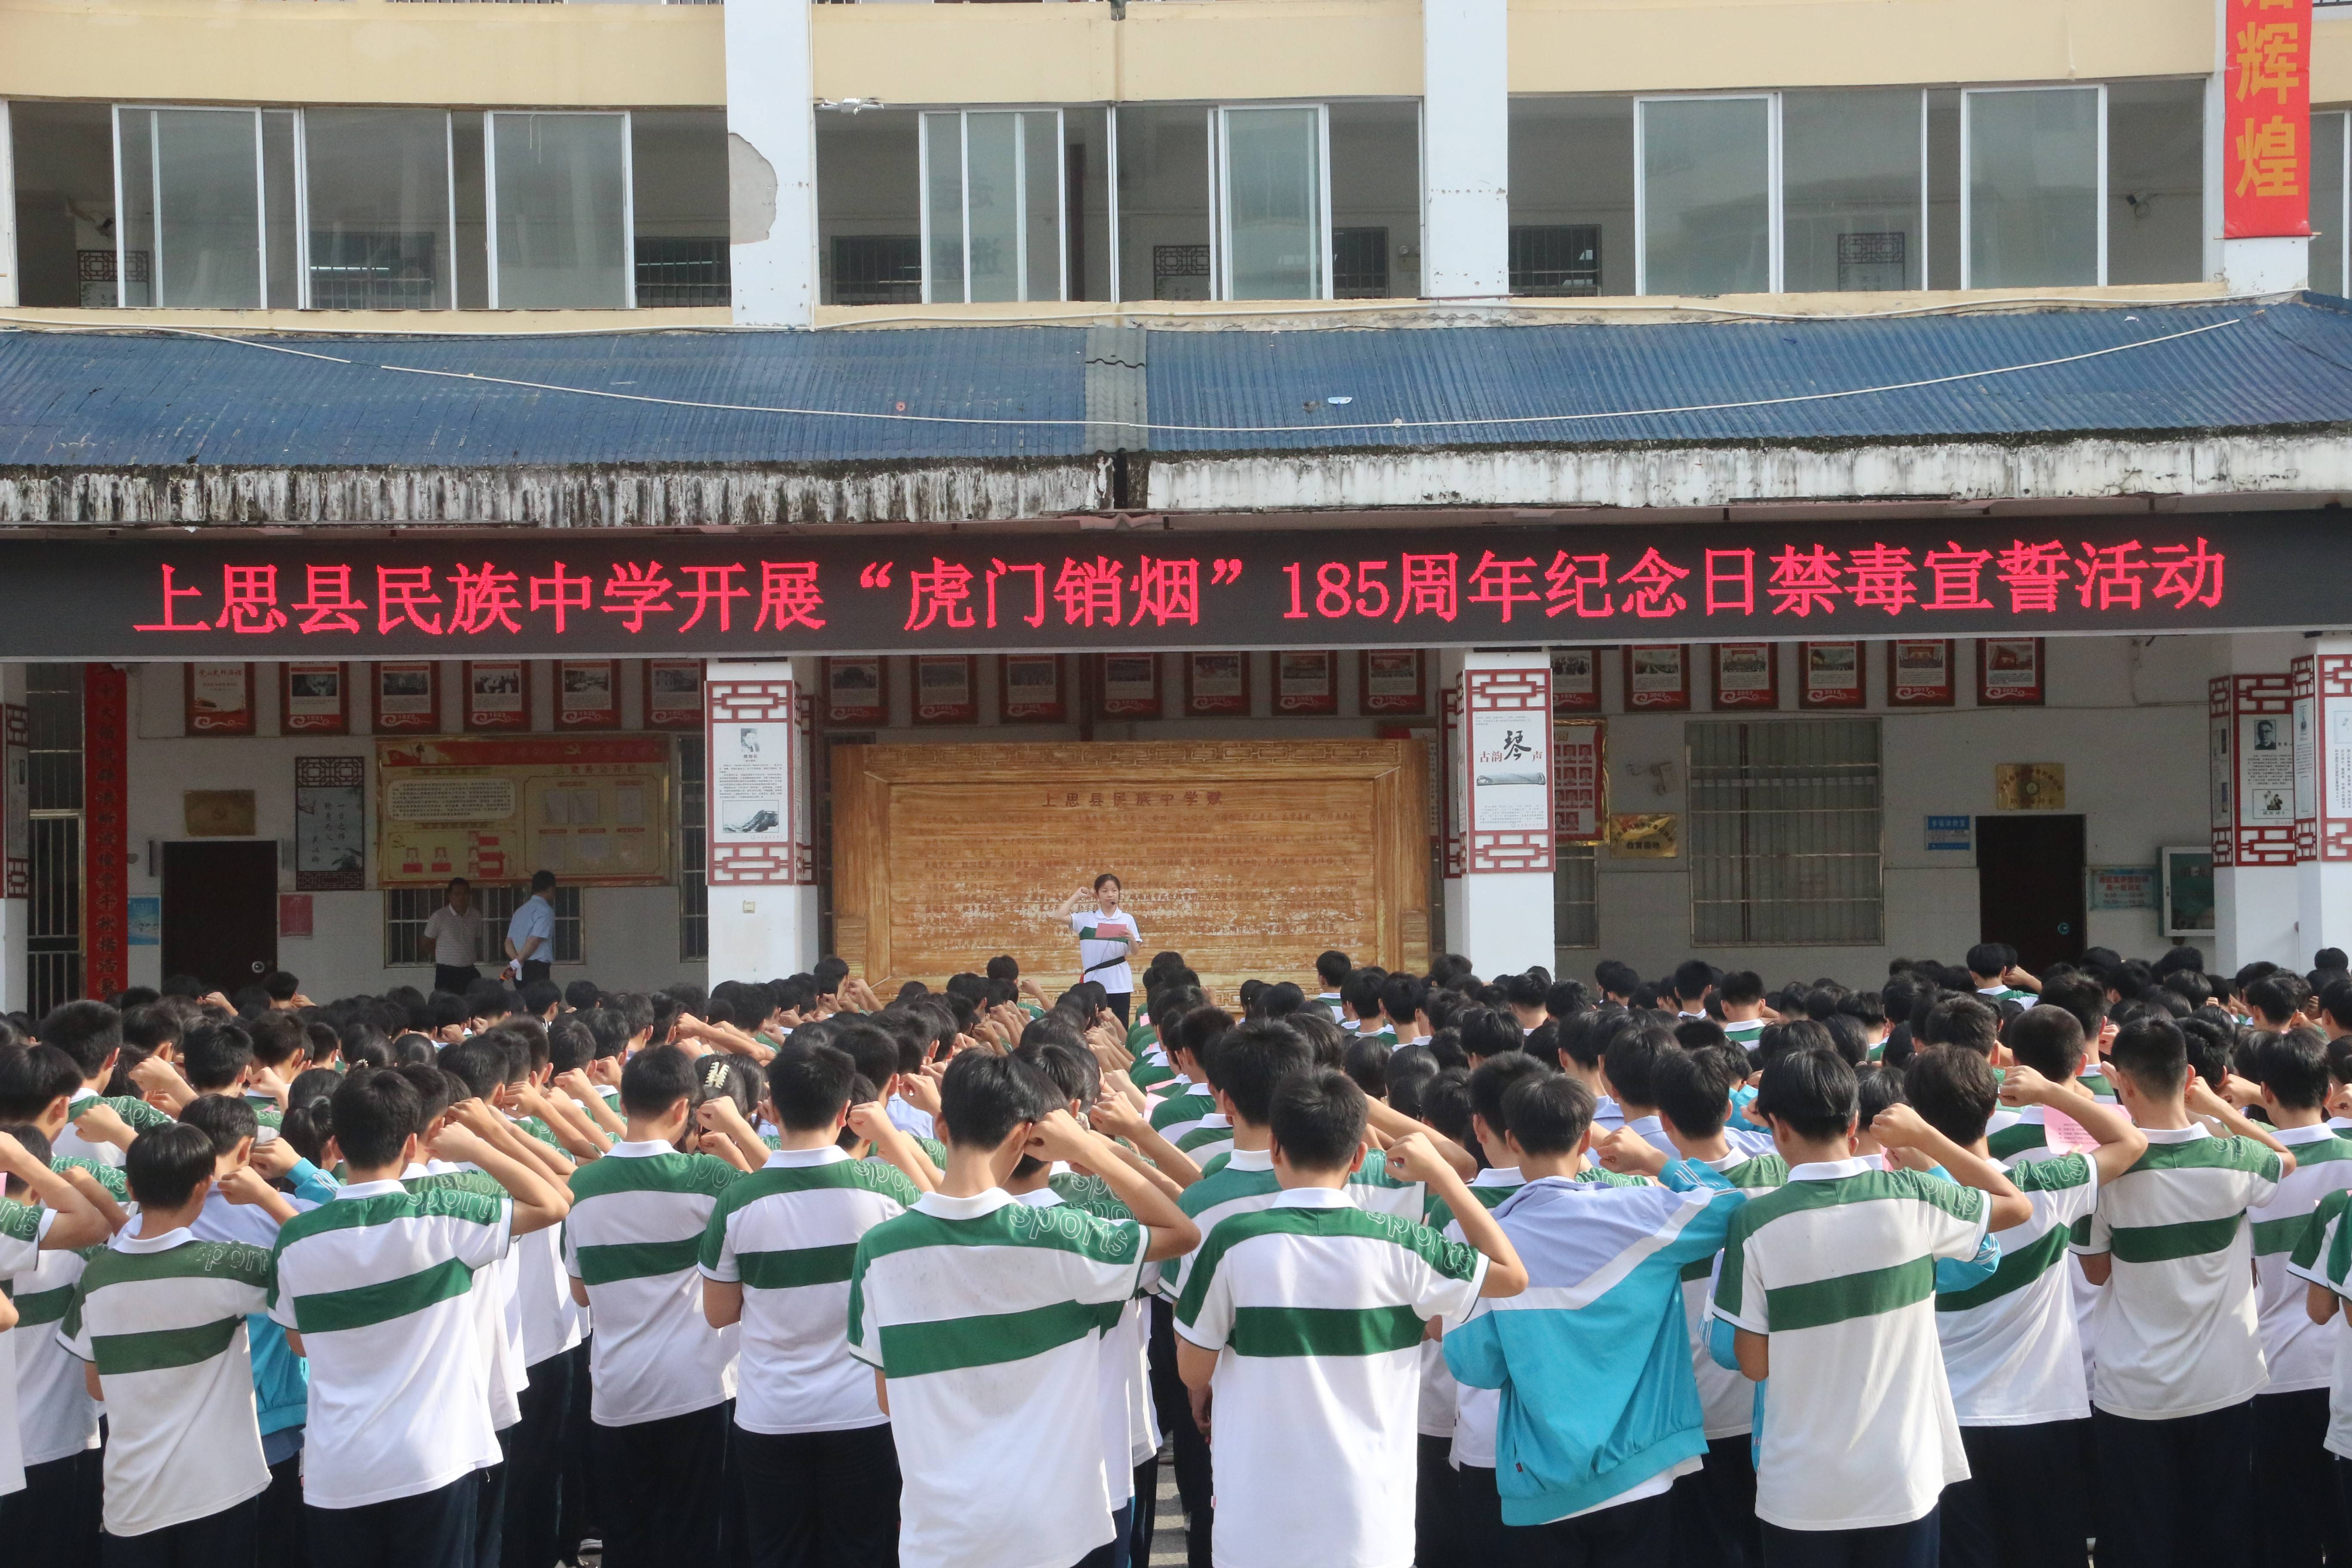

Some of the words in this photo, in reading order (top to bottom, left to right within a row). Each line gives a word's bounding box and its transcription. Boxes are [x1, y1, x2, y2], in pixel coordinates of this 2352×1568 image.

[2235, 0, 2299, 198] 辉煌
[1041, 790, 1223, 807] 上思县民族中学赋
[1009, 1204, 1129, 1256] sports
[1365, 1211, 1473, 1274] sports
